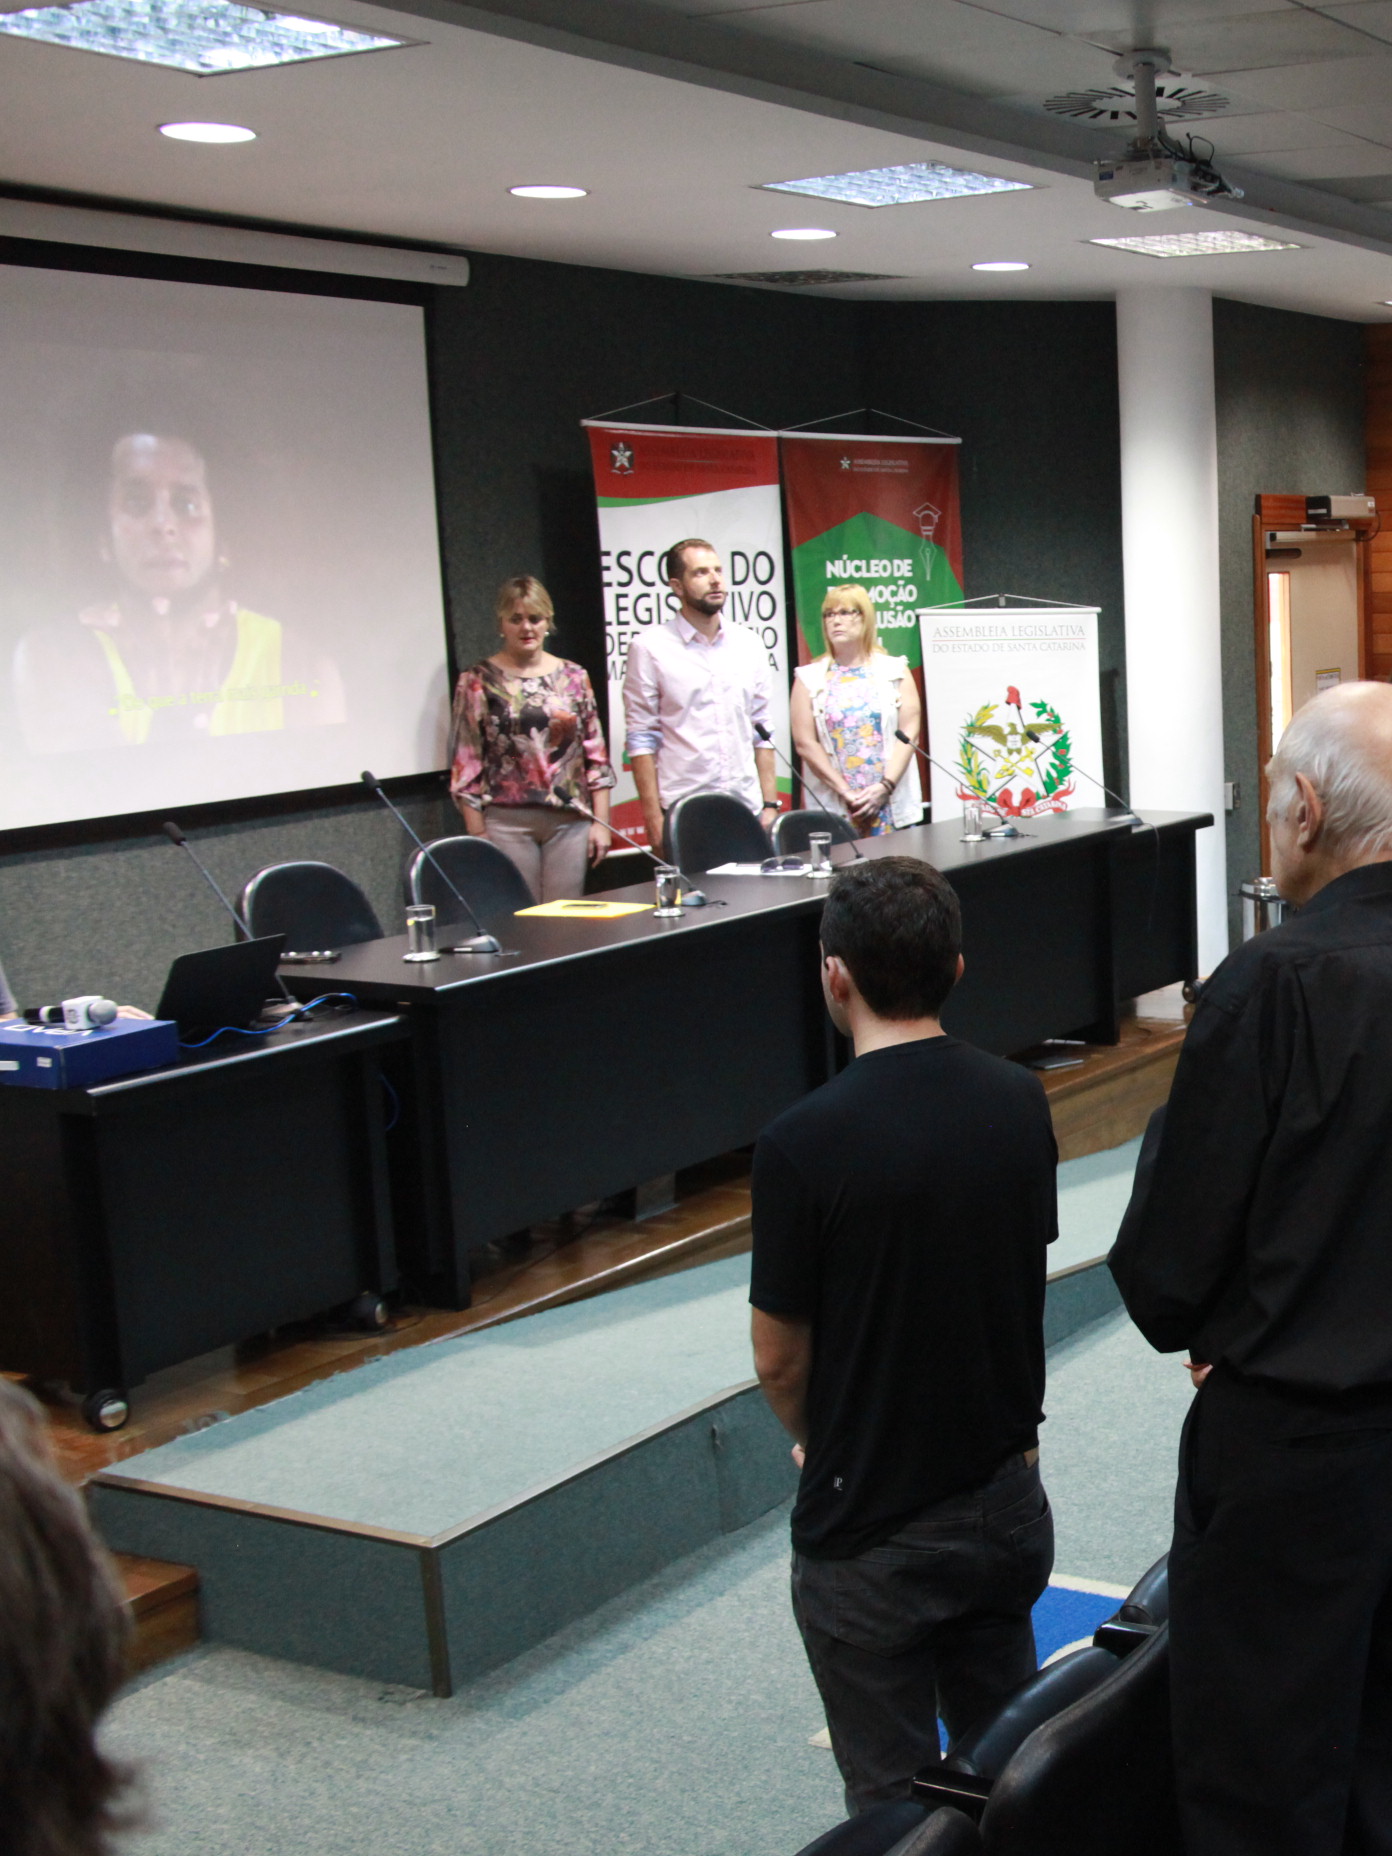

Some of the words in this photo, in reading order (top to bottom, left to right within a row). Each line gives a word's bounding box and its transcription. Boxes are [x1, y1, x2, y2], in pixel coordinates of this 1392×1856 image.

[601, 550, 669, 588] ESC
[731, 551, 775, 586] DO
[826, 554, 892, 578] NÚCLEO
[893, 559, 913, 577] DE
[605, 591, 777, 626] EGISIVO
[932, 625, 1007, 638] ASSEMBLEIA
[1012, 624, 1086, 637] LEGISLATIVA
[932, 643, 949, 653] DO
[952, 643, 990, 653] ESTADO
[992, 643, 1005, 652] DE
[1007, 642, 1037, 652] SANTA
[1040, 641, 1086, 651] CATARINA
